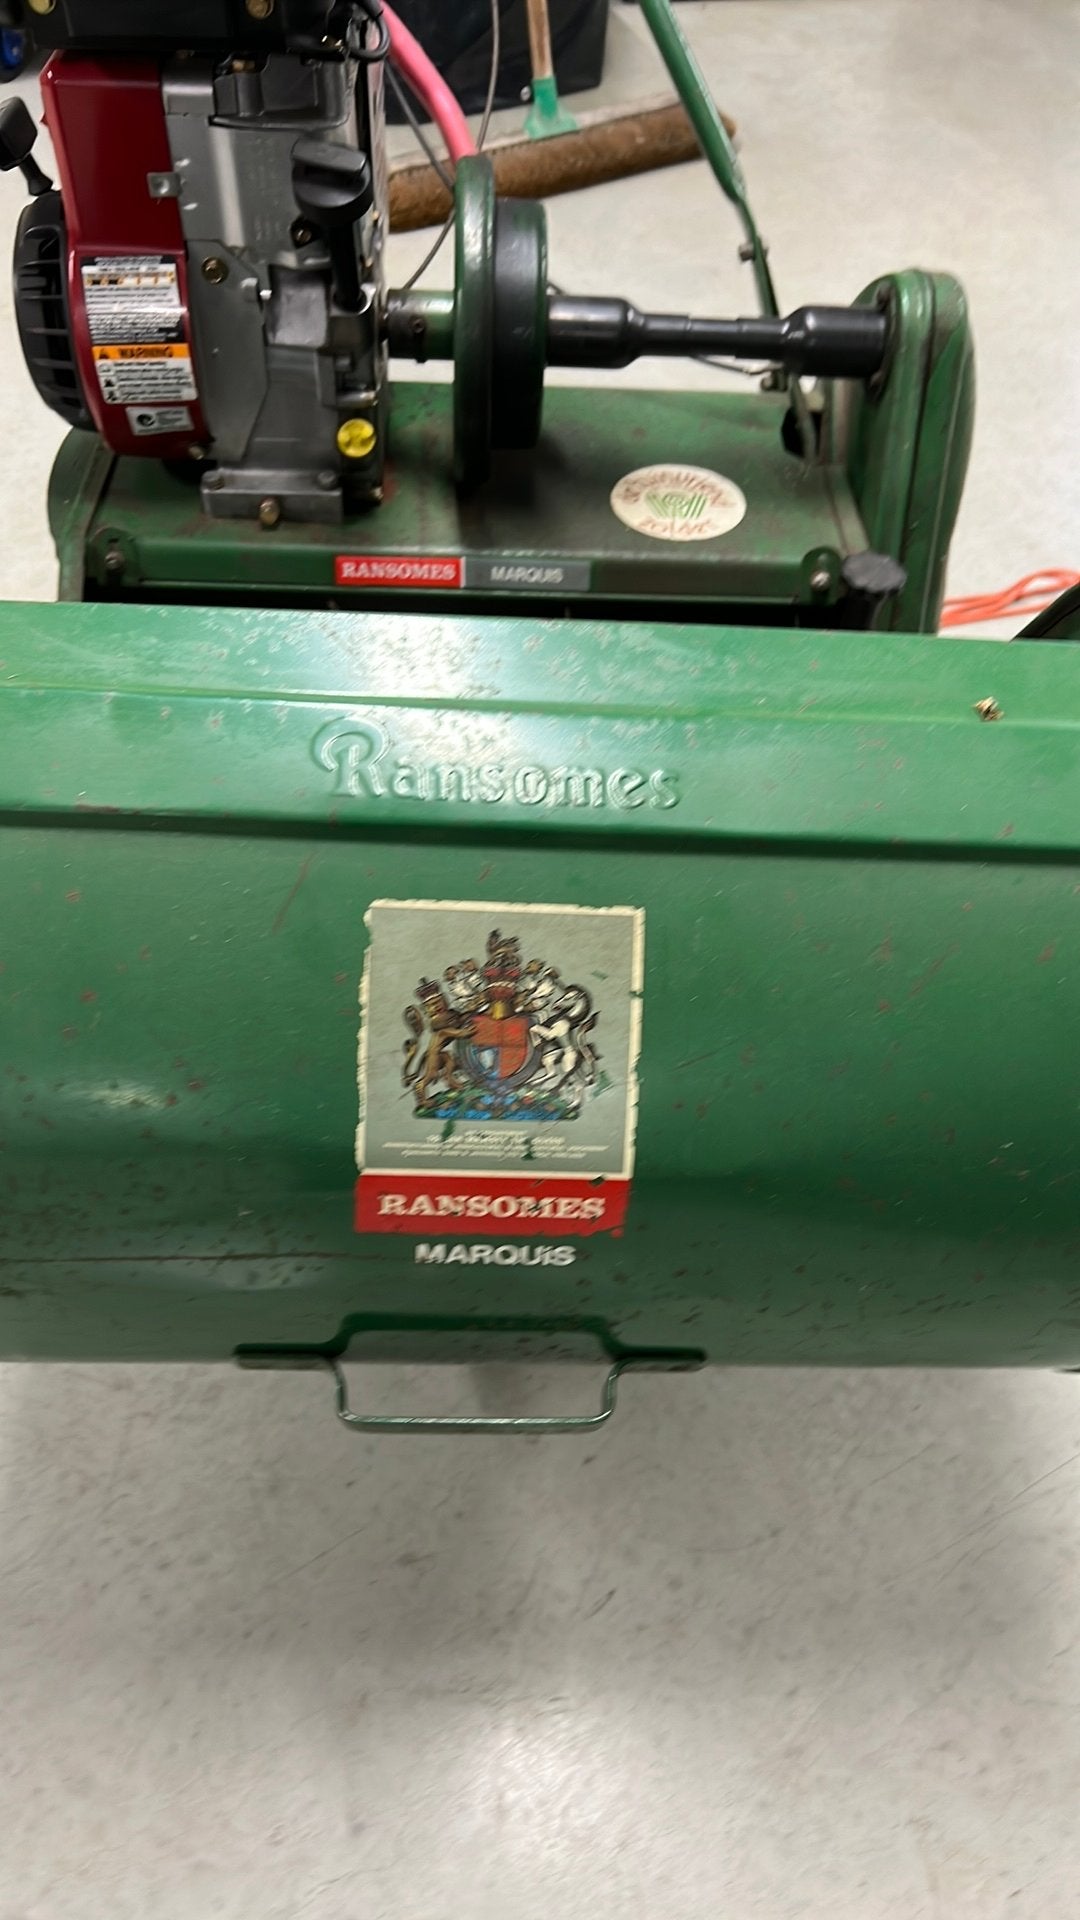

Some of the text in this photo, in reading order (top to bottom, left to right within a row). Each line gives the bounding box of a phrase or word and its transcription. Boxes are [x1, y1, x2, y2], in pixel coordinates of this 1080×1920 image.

[341, 562, 456, 581] RANSOMES
[490, 565, 565, 584] MARQUIS
[310, 716, 680, 810] Ransomes
[376, 1193, 606, 1220] RANSOMES
[414, 1243, 577, 1267] MARQUIS
